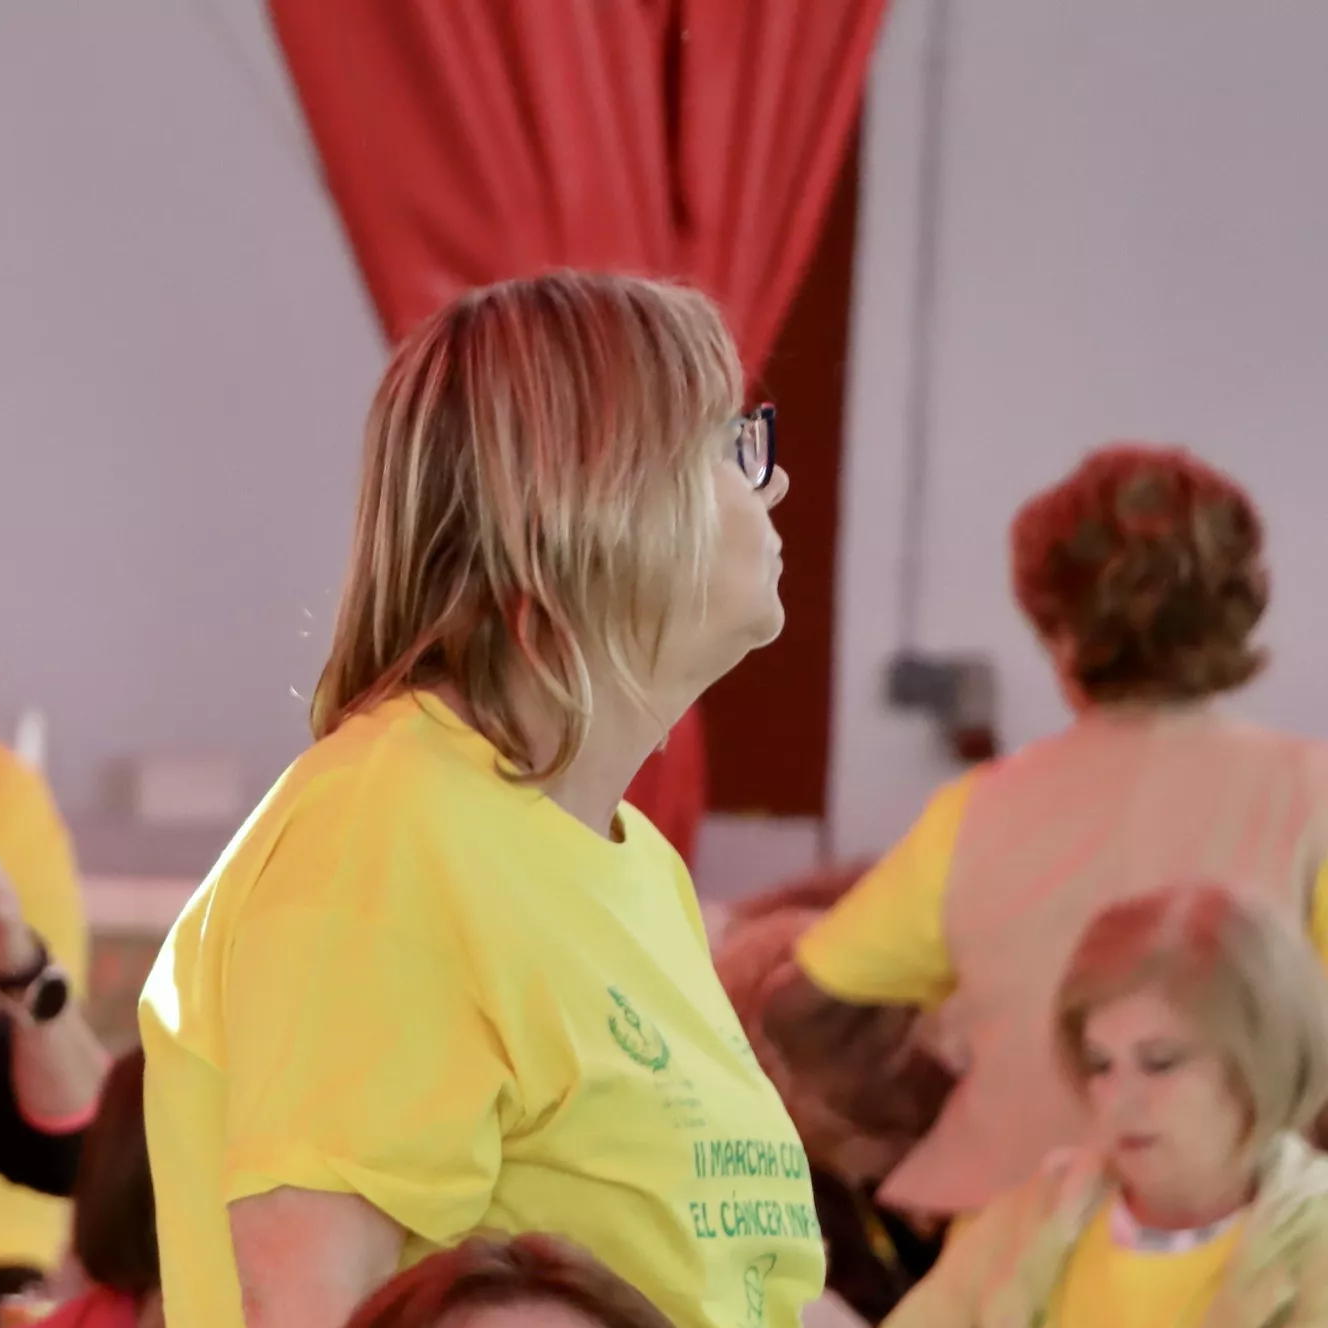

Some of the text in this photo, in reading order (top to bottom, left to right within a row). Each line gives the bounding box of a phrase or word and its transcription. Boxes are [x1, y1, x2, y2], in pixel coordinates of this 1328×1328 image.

[710, 1139, 779, 1177] MARCHA
[690, 1201, 717, 1238] EL
[720, 1190, 782, 1238] CÁNCER
